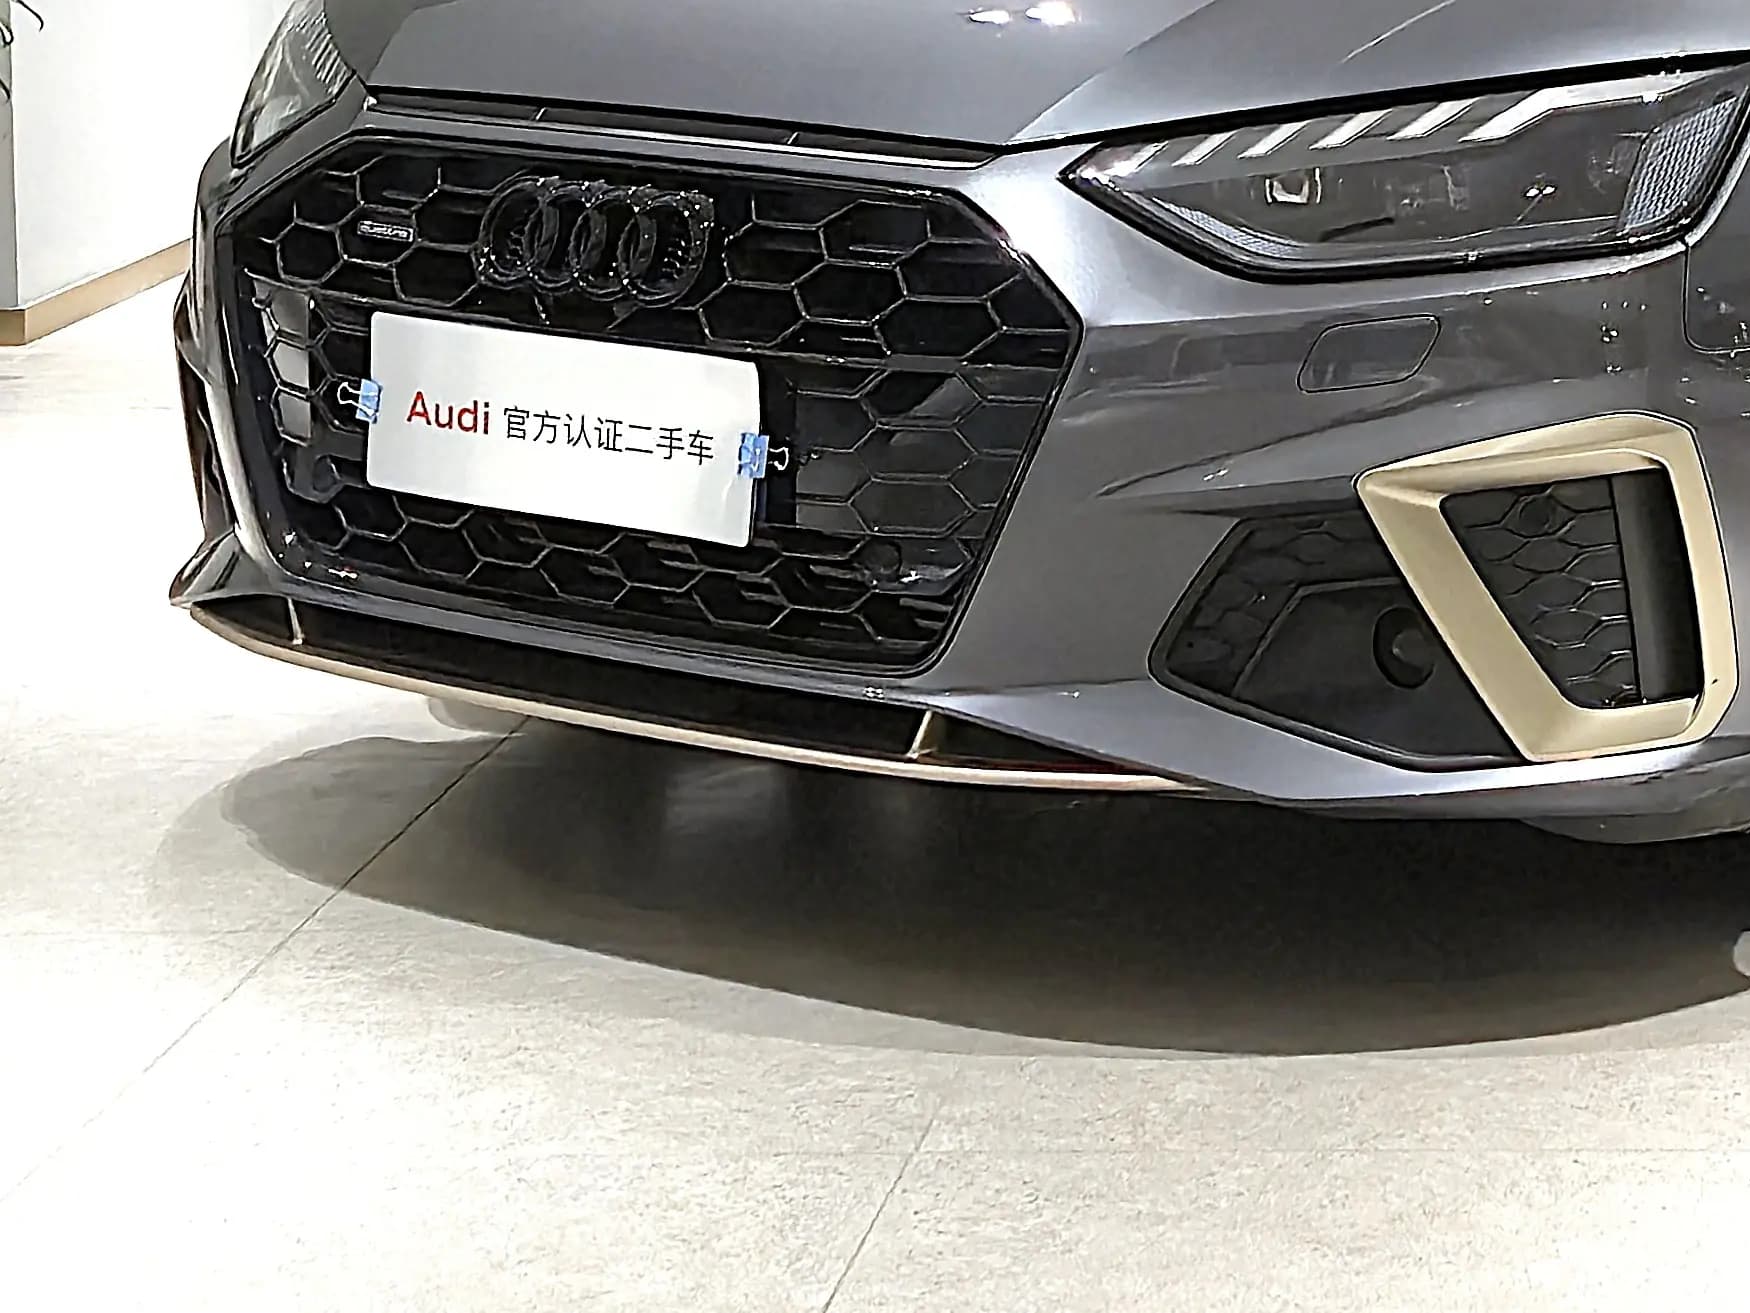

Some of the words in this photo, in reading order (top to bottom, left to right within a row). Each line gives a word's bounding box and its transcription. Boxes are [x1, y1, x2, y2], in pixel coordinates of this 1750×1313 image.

[405, 390, 491, 436] Audi
[503, 405, 716, 466] 官方认证二手车
